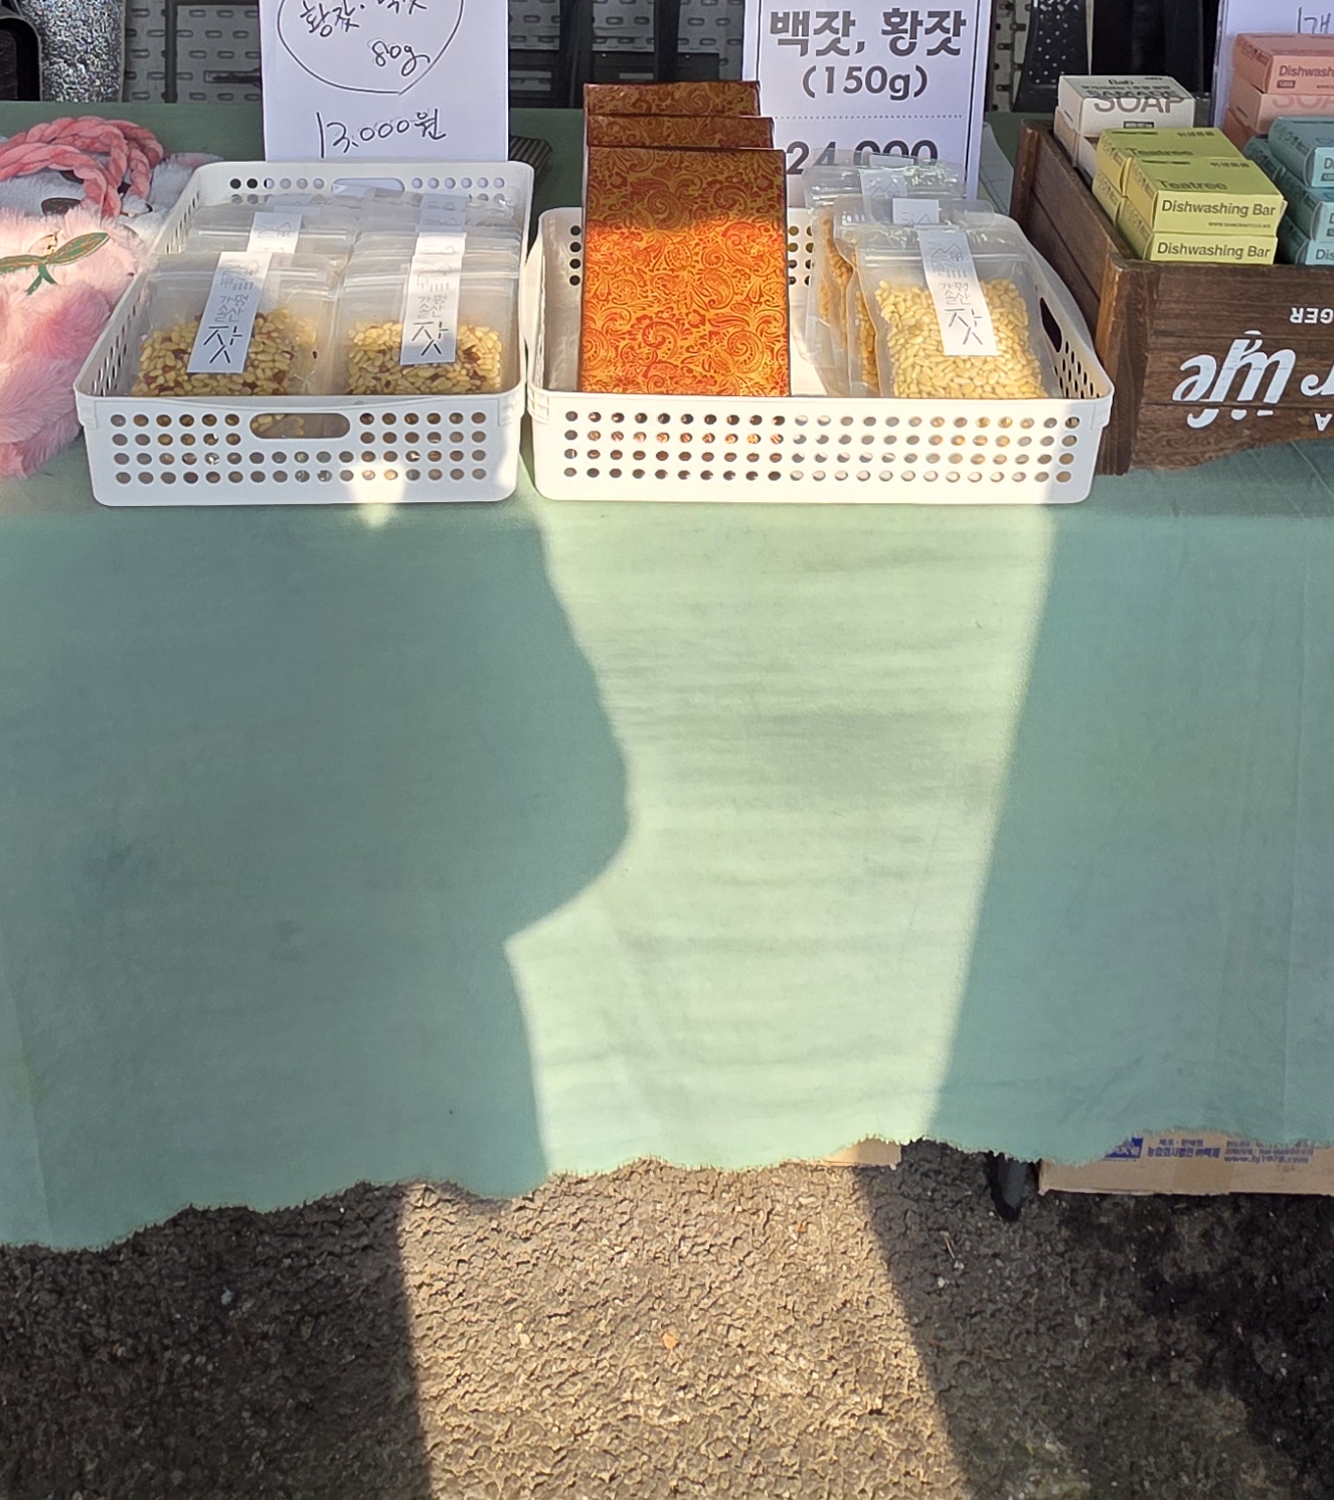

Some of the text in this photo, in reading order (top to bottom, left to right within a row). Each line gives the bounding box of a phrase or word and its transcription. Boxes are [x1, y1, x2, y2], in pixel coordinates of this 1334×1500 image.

[768, 7, 968, 57] 백잣, 황잣
[1296, 7, 1332, 35] 1개
[371, 40, 431, 77] 80g
[802, 64, 928, 102] (150g)
[1155, 178, 1229, 191] Teatree
[1161, 199, 1277, 218] Dishwashing Bar
[1156, 241, 1271, 260] Dishwashing Bar
[203, 325, 244, 364] 잣
[411, 321, 449, 356] 잣
[943, 308, 983, 346] 잣
[1312, 412, 1327, 432] A
